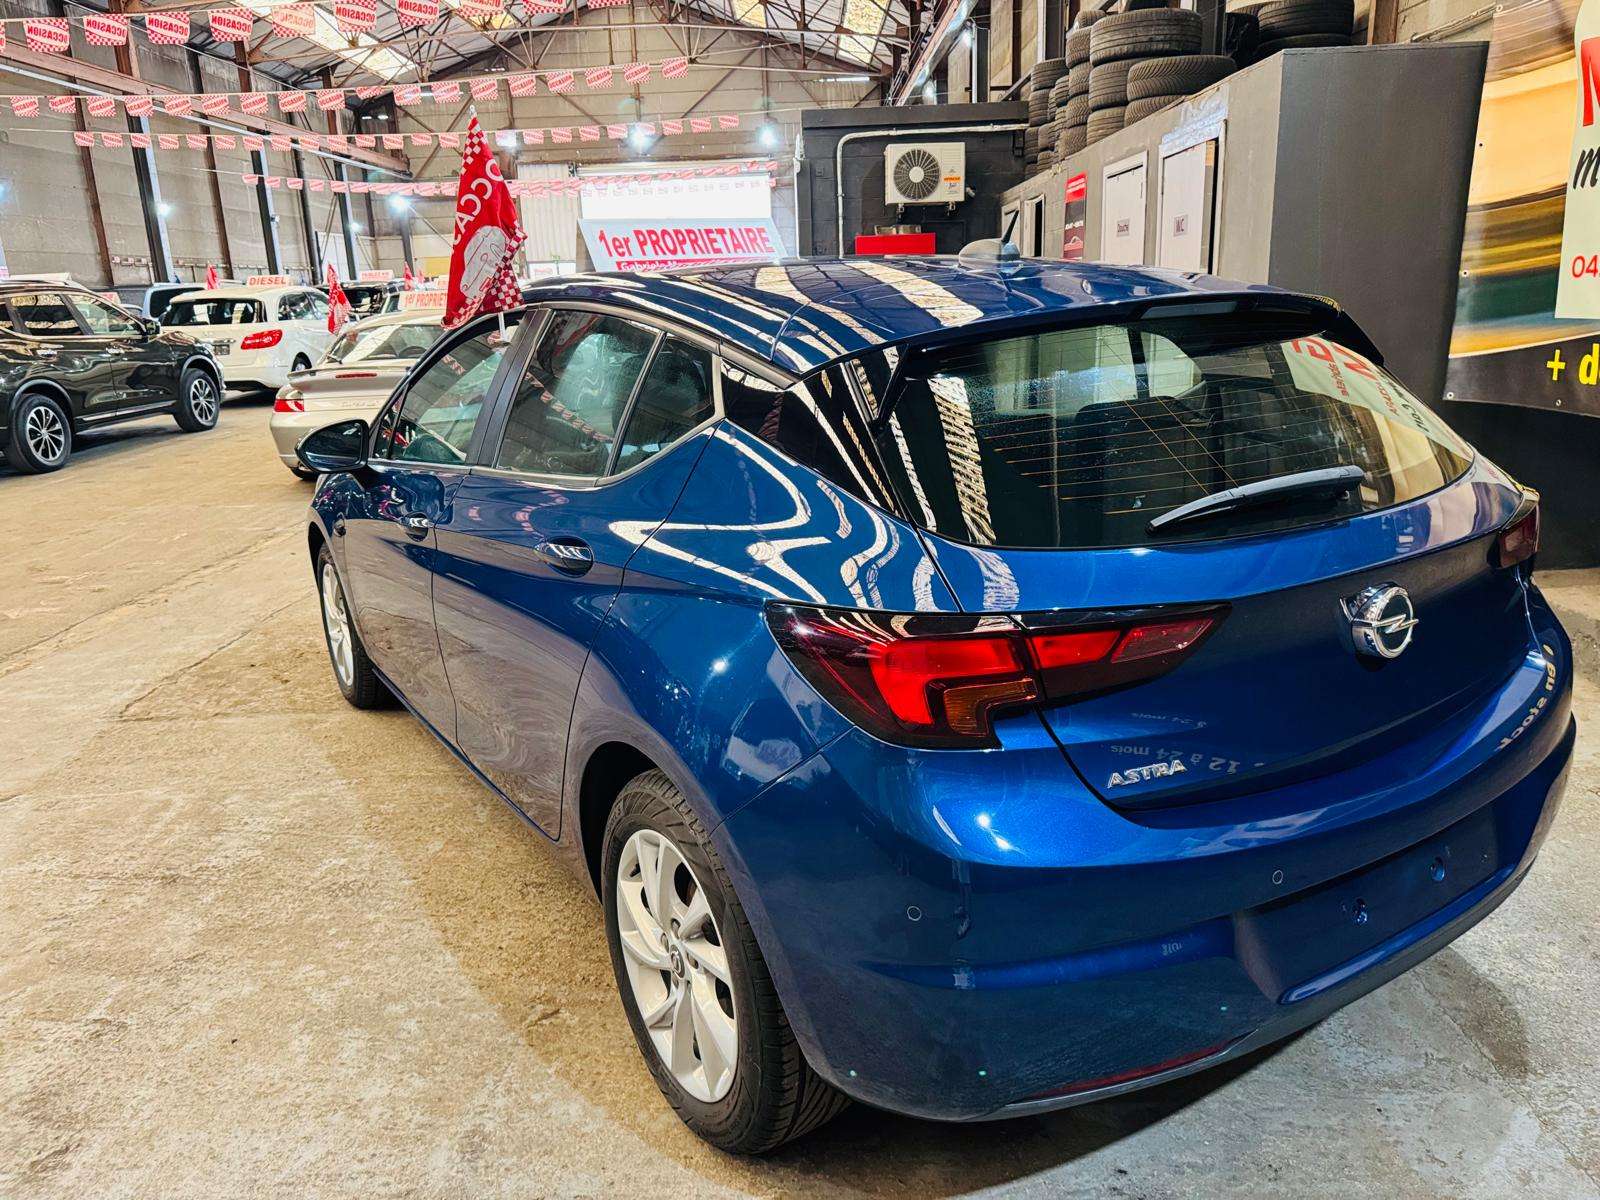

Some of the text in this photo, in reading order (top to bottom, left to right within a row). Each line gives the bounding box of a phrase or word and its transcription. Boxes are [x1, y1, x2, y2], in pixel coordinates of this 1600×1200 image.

[598, 226, 775, 258] 1er PROPRIETAIRE
[249, 276, 286, 286] DIESEL
[1106, 758, 1188, 788] ASTRA
